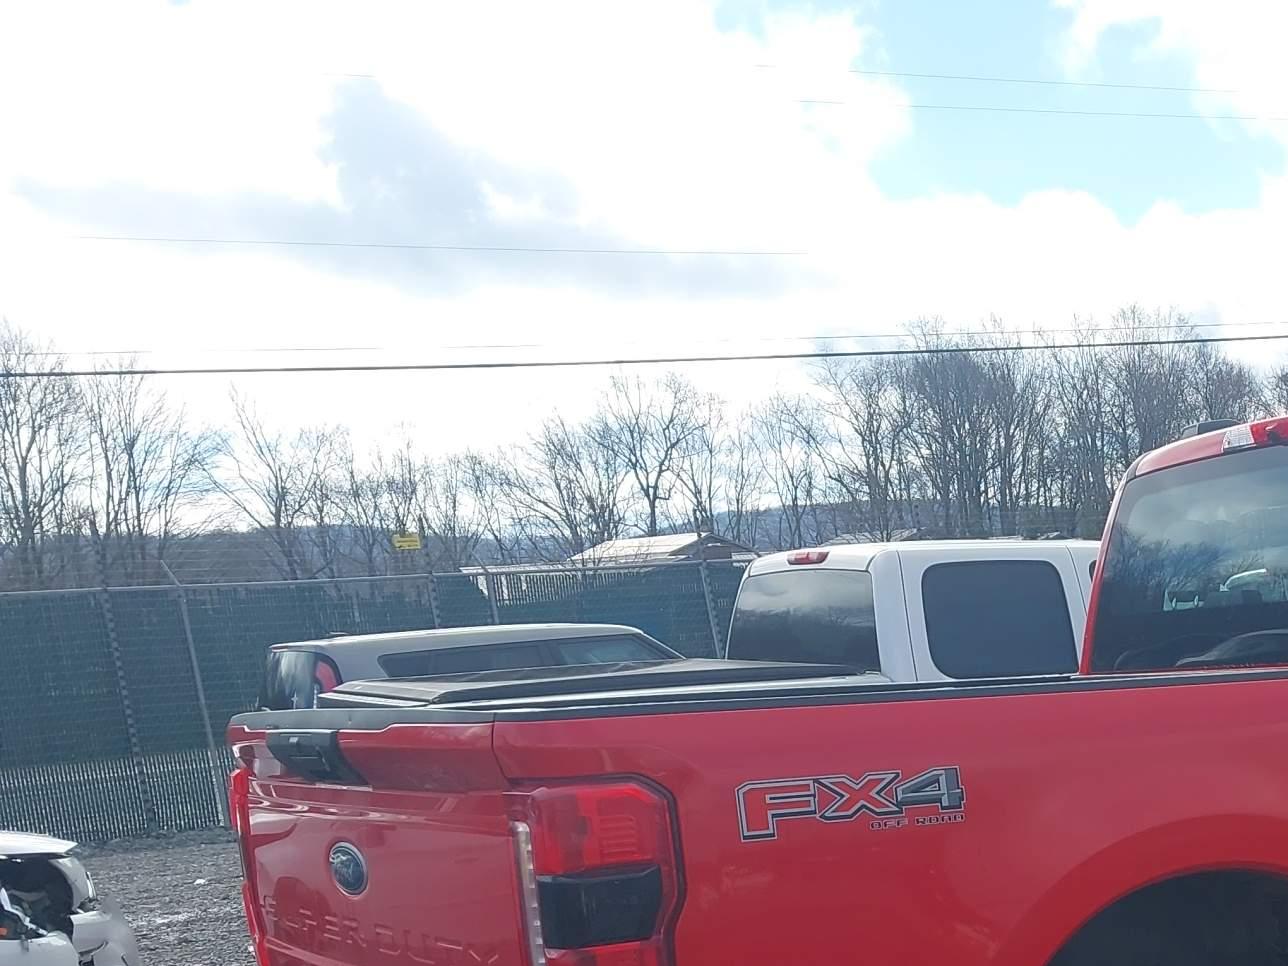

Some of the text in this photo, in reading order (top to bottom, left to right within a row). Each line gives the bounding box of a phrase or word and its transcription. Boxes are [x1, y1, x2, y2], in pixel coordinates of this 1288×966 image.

[735, 765, 966, 842] FX4
[869, 812, 966, 831] OFF ROAD
